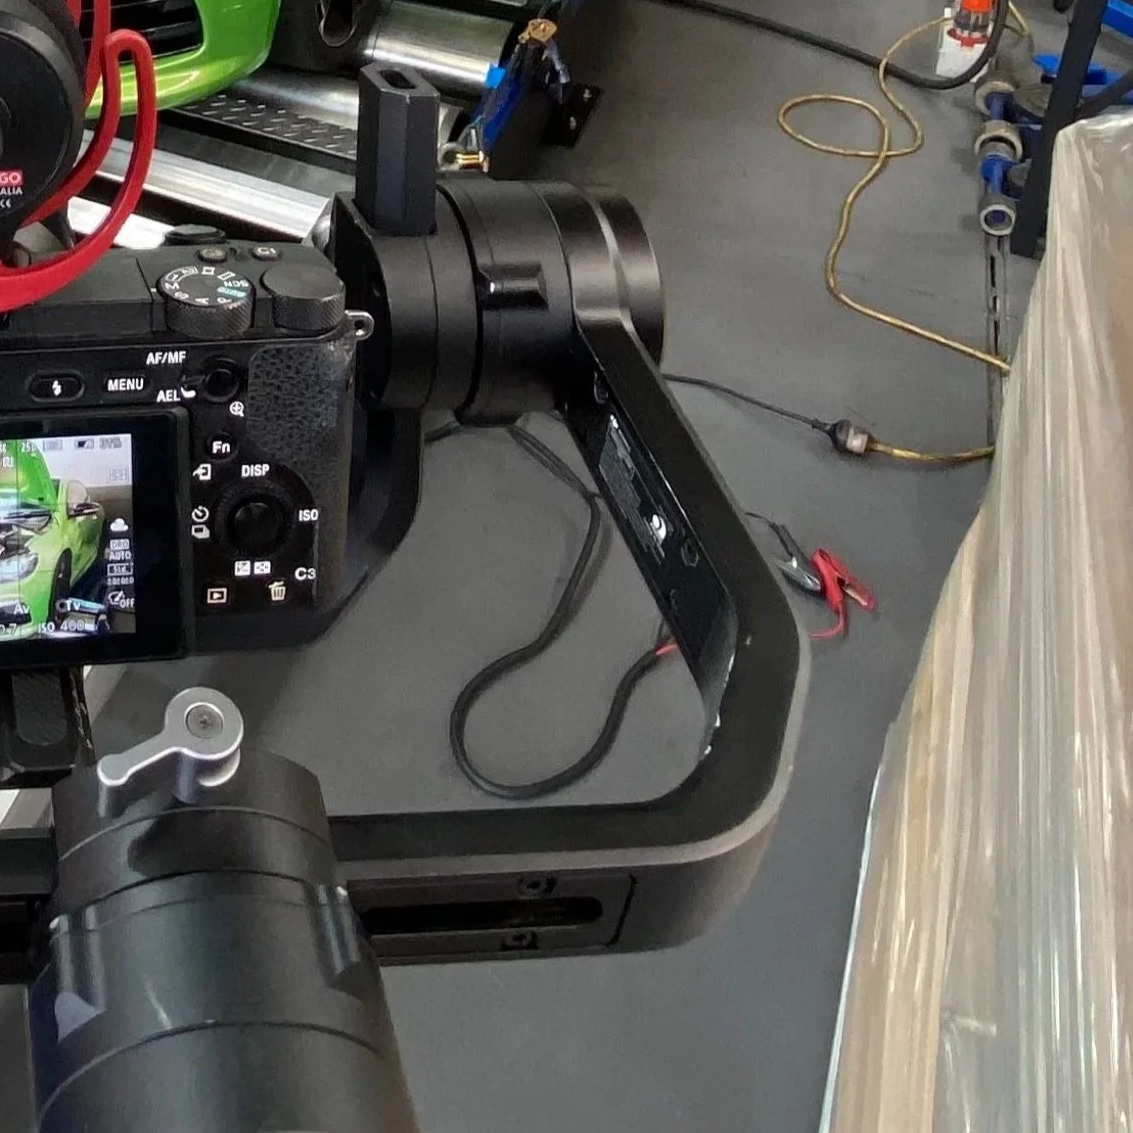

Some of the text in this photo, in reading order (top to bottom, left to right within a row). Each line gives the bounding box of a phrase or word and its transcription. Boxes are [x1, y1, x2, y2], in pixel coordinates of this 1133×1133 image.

[146, 350, 187, 365] AF/MF
[107, 377, 144, 391] MENU
[156, 389, 181, 403] AEL
[212, 441, 231, 454] Fn
[241, 463, 270, 478] DISP
[298, 509, 319, 522] ISO
[294, 566, 317, 581] C3
[120, 597, 135, 608] OFF
